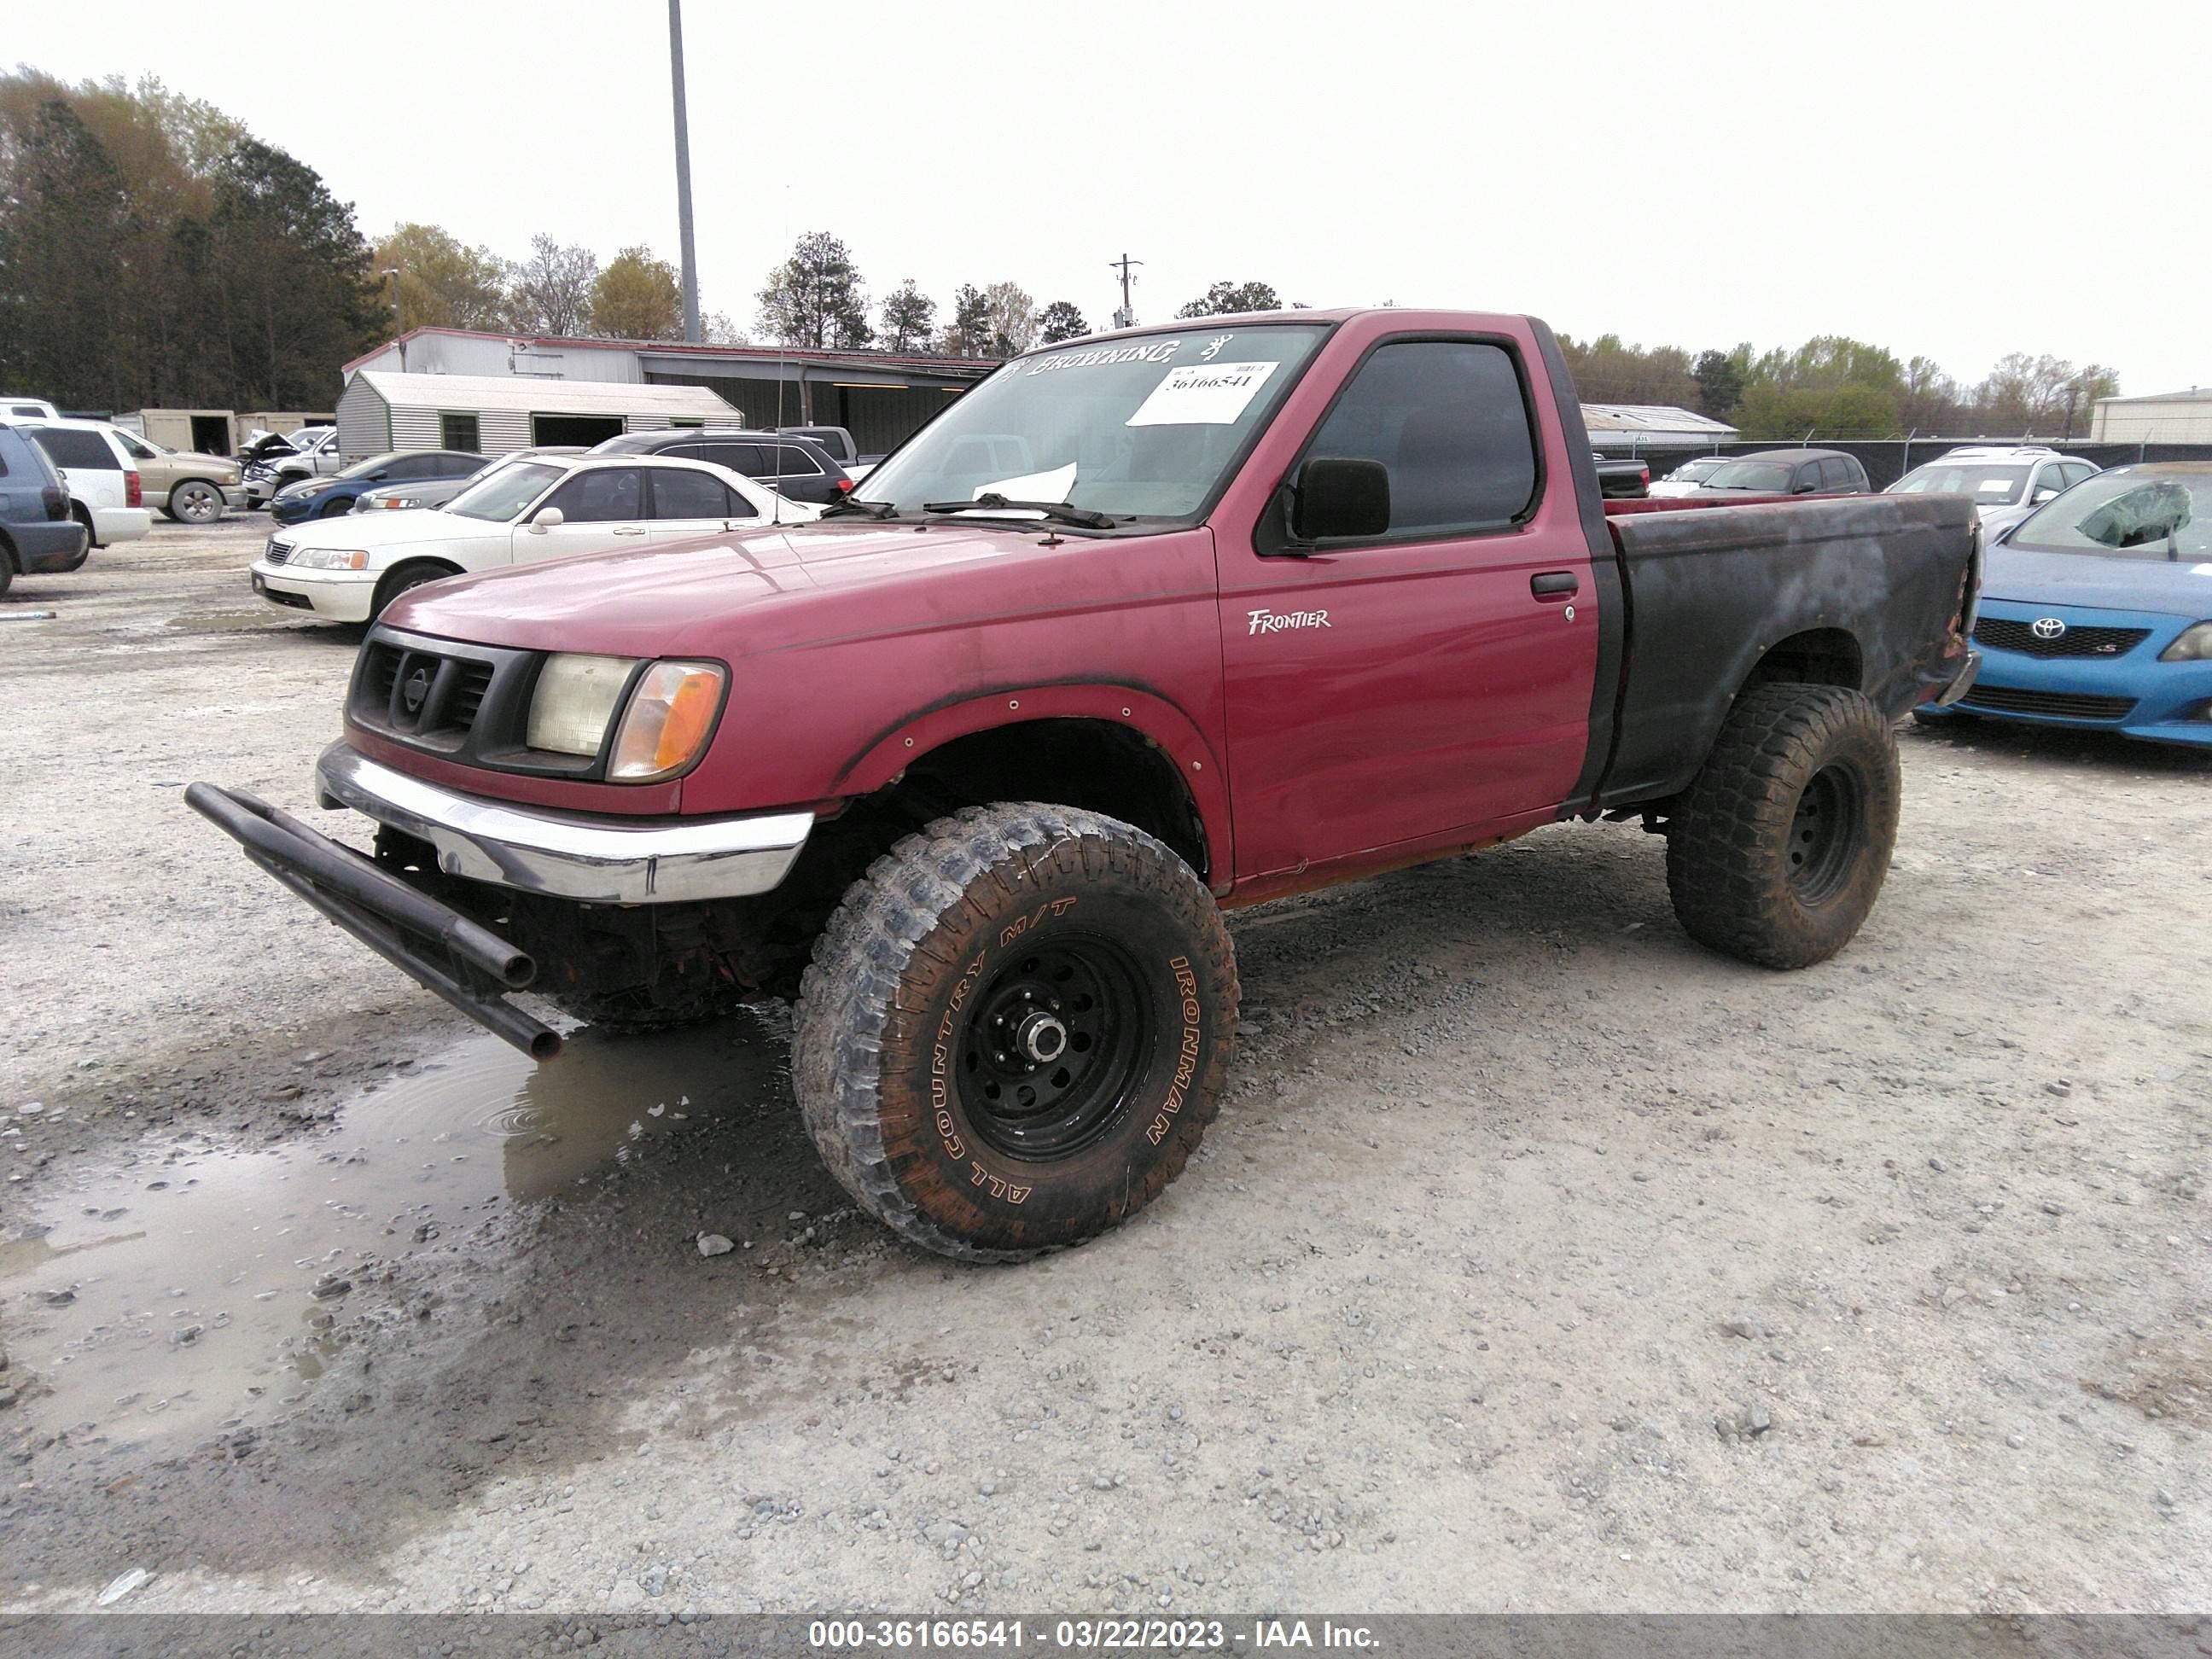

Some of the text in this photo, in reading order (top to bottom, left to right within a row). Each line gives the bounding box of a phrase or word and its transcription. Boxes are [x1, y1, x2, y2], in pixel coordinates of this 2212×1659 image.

[1167, 375, 1252, 391] 36166541
[931, 897, 1077, 1204] ALL COUNTRY M/T
[1146, 956, 1202, 1146] IRONMAN
